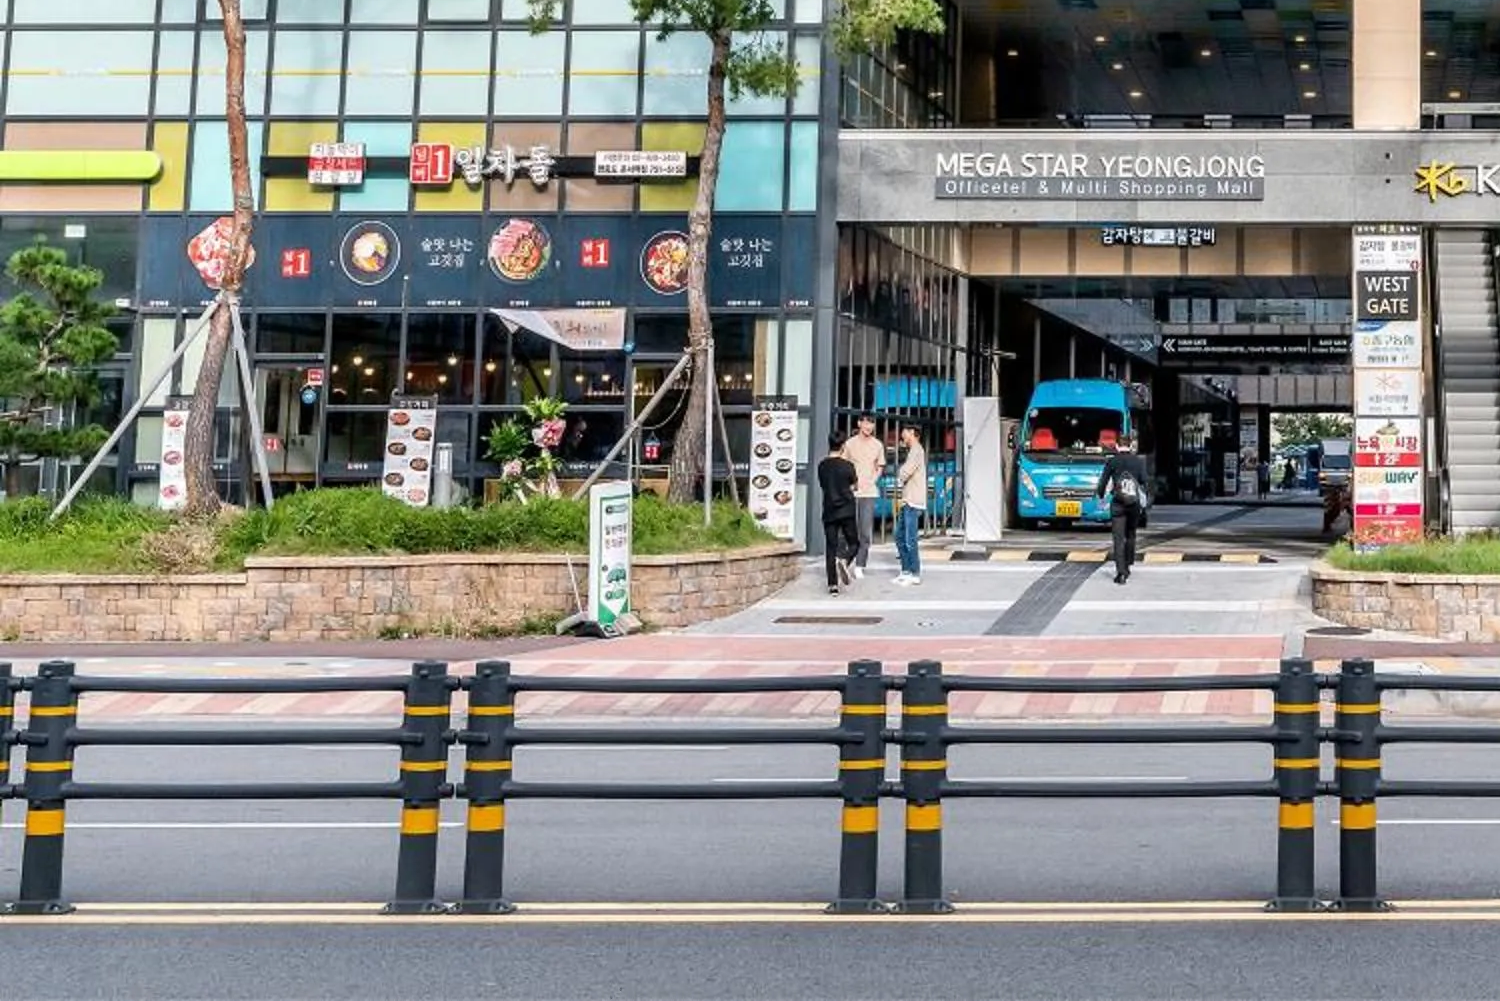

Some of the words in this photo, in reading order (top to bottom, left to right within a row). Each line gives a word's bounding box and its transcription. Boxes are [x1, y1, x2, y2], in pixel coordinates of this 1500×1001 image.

[455, 145, 556, 186] 일차돌
[936, 153, 1013, 177] MEGA
[1020, 153, 1088, 177] STAR
[1099, 155, 1265, 178] YEONGJONG
[945, 181, 1027, 195] Officetel
[1039, 181, 1049, 195] &
[1061, 180, 1108, 195] Multi
[1119, 181, 1207, 197] Shopping
[1217, 180, 1254, 195] Mall
[1103, 227, 1142, 244] 감자탕
[1176, 227, 1216, 246] 불갈비
[449, 237, 475, 253] 나는
[719, 238, 745, 253] 술맛
[748, 238, 774, 253] 나는
[427, 253, 466, 268] 고깃집
[727, 254, 764, 268] 고깃집
[1364, 276, 1411, 292] WEST
[1367, 298, 1409, 314] GATE
